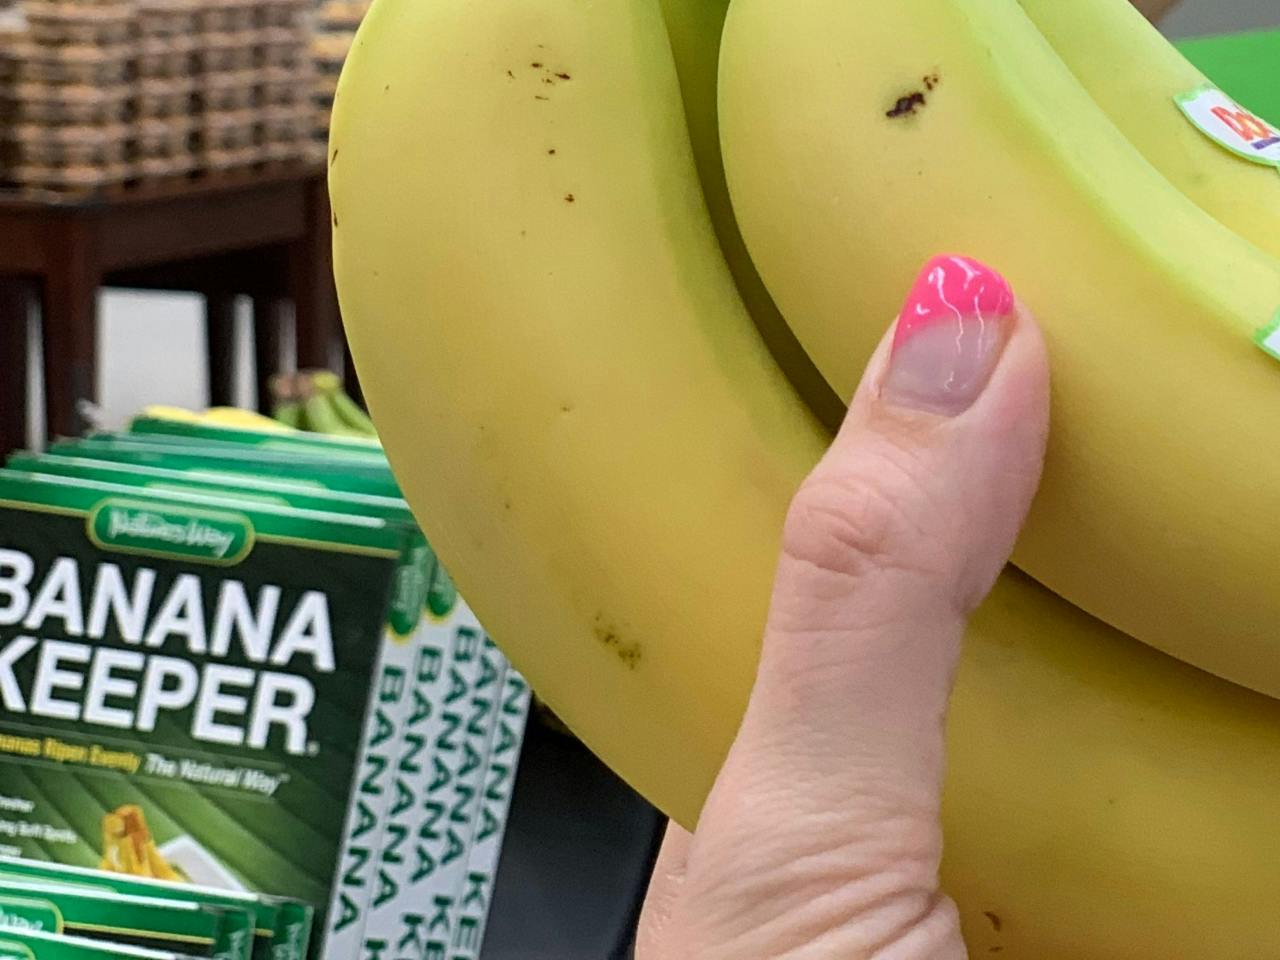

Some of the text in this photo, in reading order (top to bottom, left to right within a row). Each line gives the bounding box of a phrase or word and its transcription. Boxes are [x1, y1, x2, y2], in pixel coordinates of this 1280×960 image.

[0, 548, 336, 673] BANANA
[145, 752, 177, 778] The
[178, 758, 243, 788] Natural
[332, 664, 406, 932] BANANA
[372, 645, 443, 909] BANANA
[410, 625, 478, 884] BANANA
